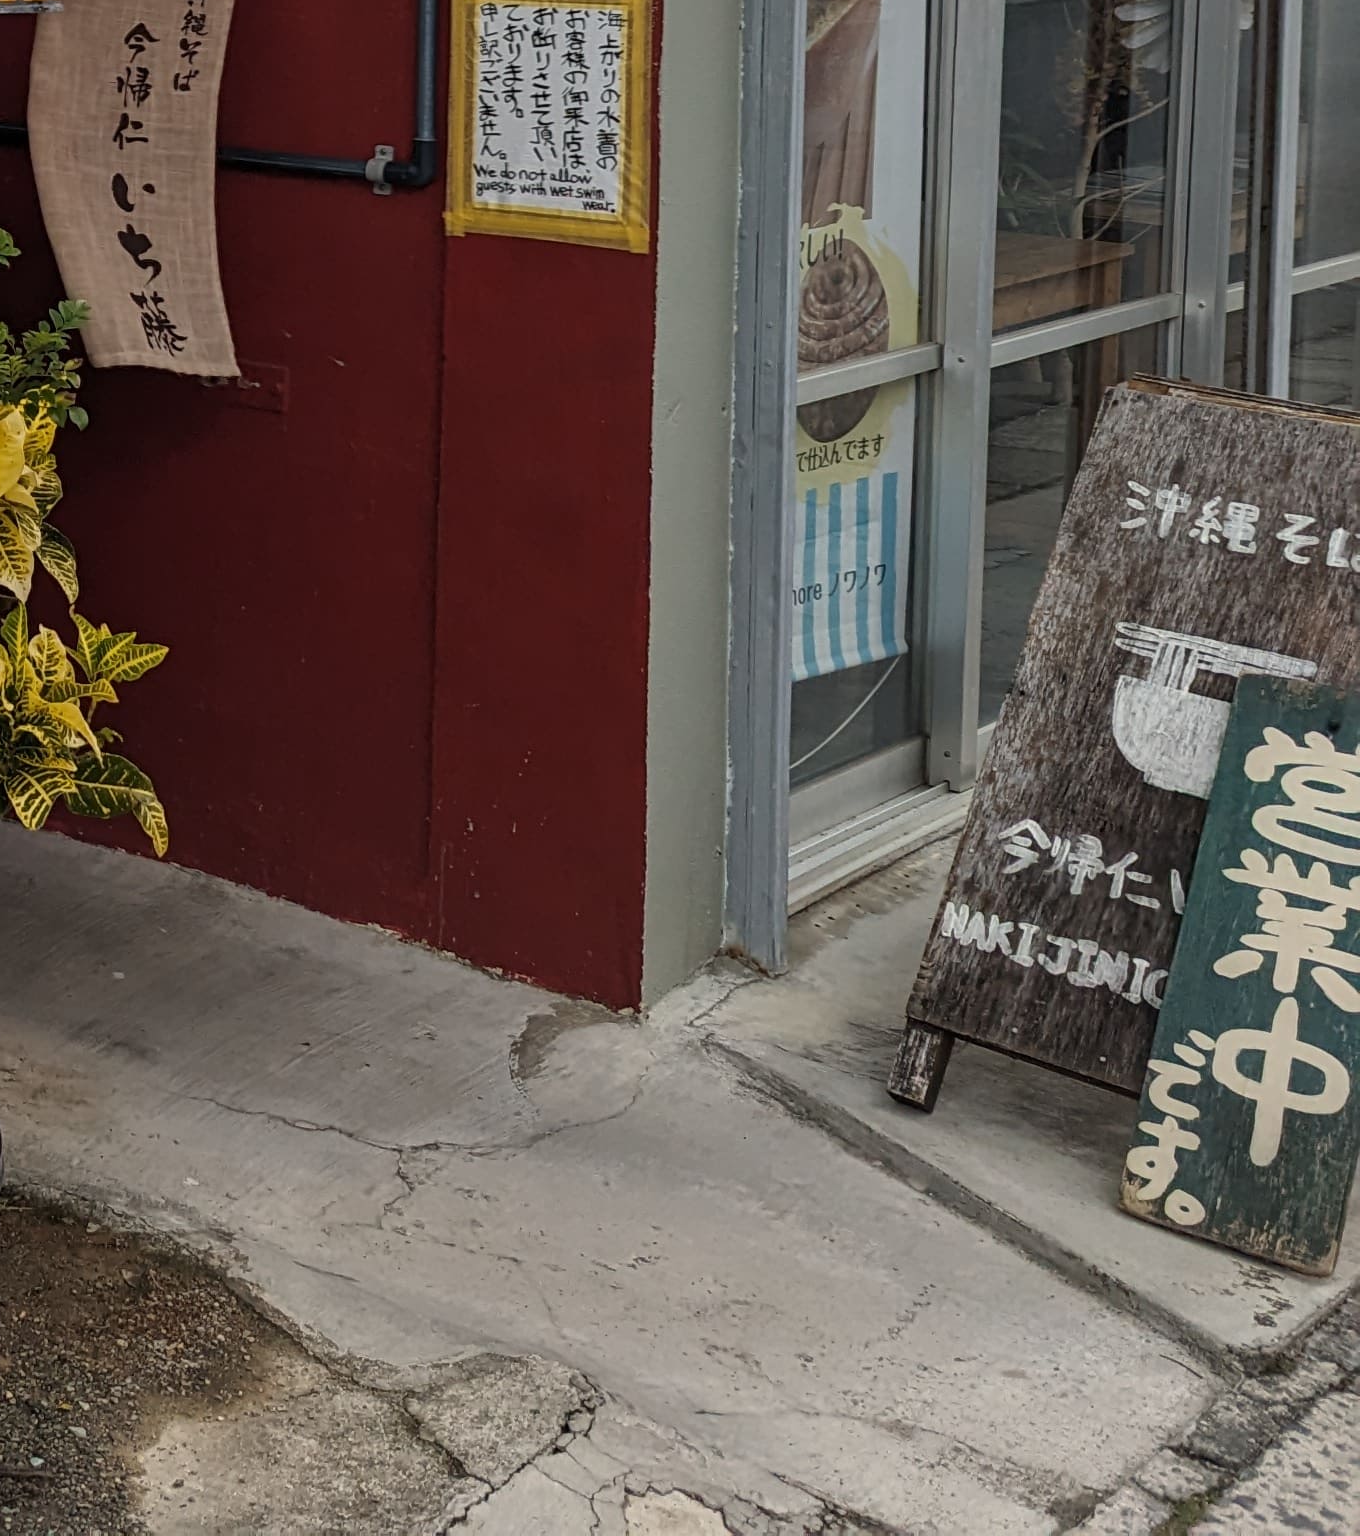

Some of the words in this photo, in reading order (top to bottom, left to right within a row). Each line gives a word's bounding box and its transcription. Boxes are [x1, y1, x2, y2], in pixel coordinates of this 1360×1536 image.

[478, 1, 508, 161] 申し訳ございません。
[501, 3, 530, 119] ております。
[528, 6, 559, 163] お断りさせて頂い
[594, 9, 627, 173] 海上がりの水着の
[473, 162, 497, 179] We
[499, 161, 517, 180] do
[518, 168, 548, 182] not
[549, 167, 593, 185] allow
[475, 180, 517, 197] guests
[519, 181, 548, 197] with
[549, 184, 574, 198] wet
[575, 186, 606, 200] swim
[581, 200, 616, 214] wear.
[1211, 724, 1360, 1167] 営業中
